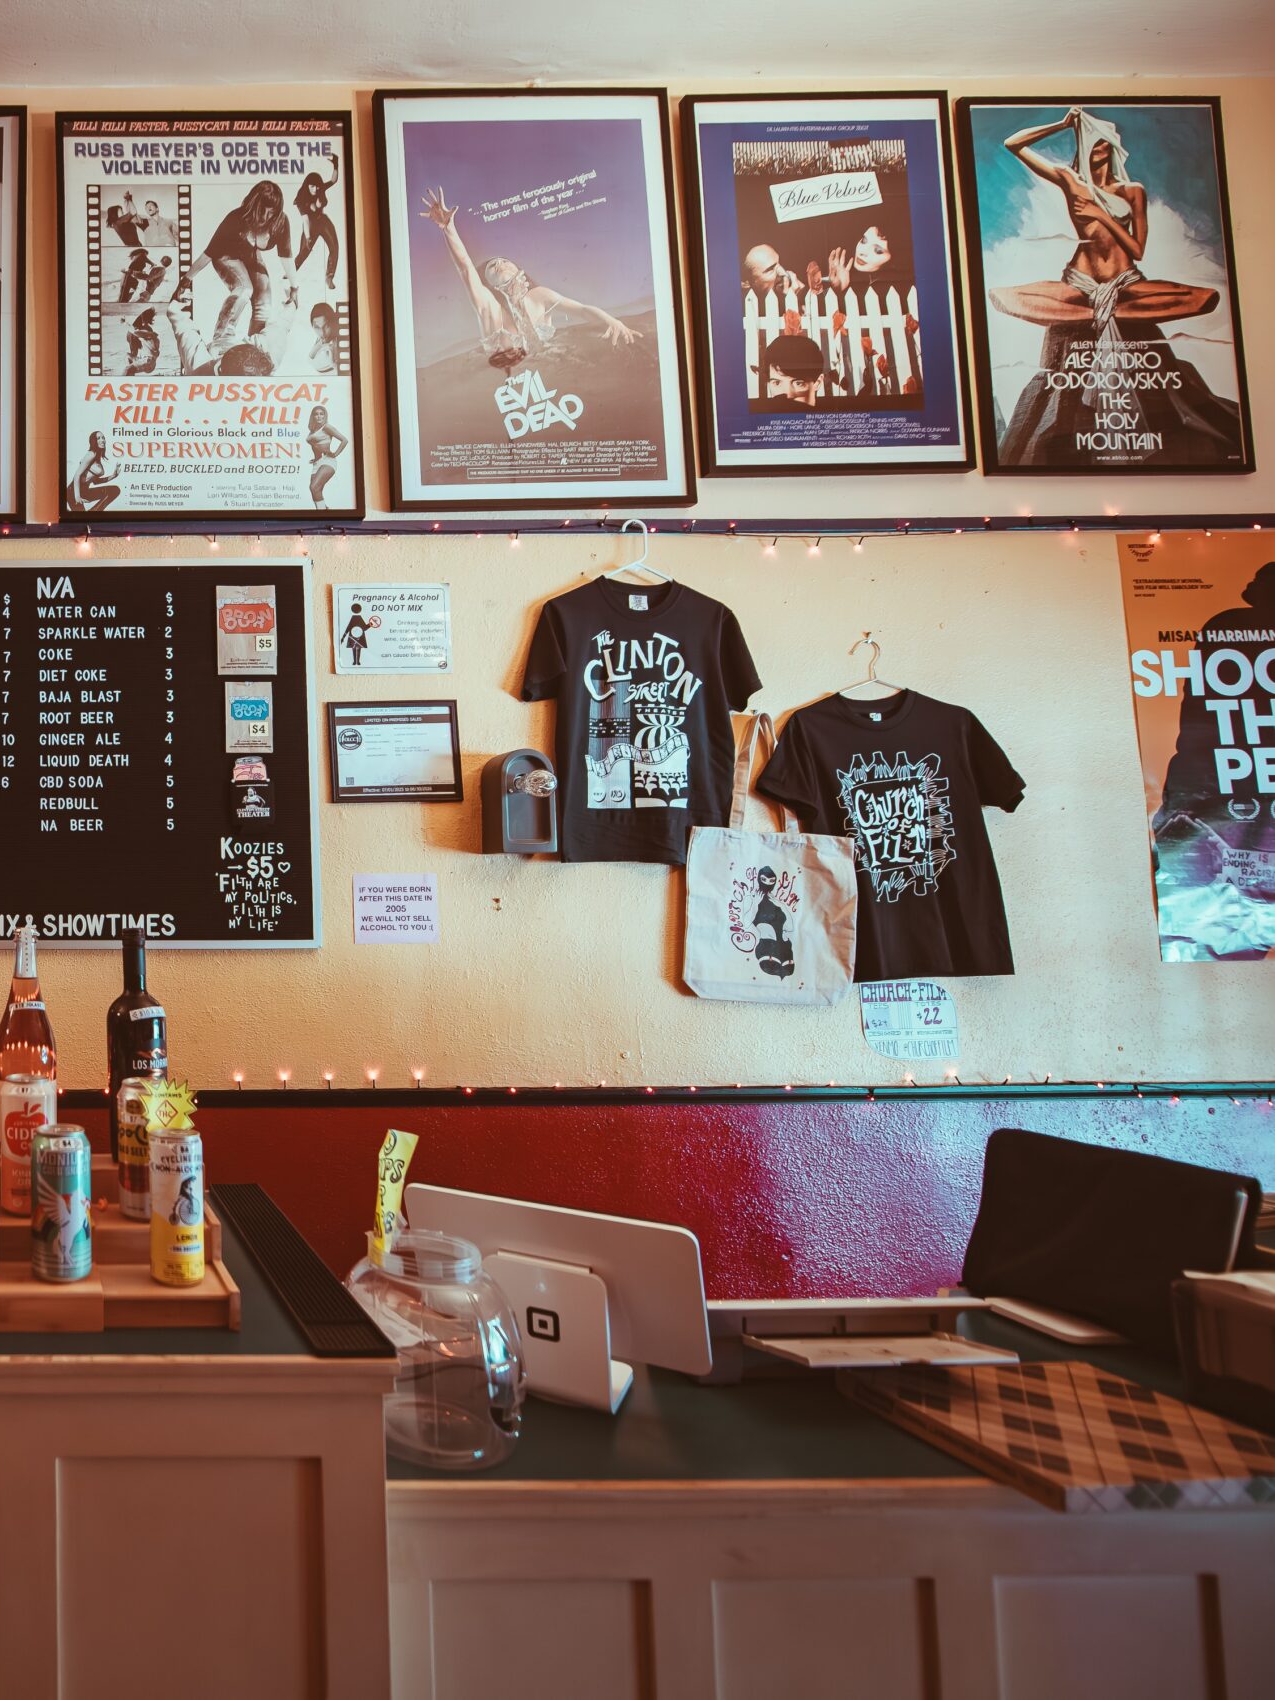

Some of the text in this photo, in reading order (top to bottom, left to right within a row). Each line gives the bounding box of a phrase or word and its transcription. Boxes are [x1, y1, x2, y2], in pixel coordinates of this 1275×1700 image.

[75, 143, 214, 157] RUSS MEYER'S
[102, 160, 304, 175] VIOLENCE IN WOMEN
[779, 180, 876, 209] Blue Velvet
[1065, 351, 1161, 369] ALEXANDRO
[1044, 372, 1182, 389] JODOROWSKY'S
[85, 383, 178, 402] FASTER
[494, 369, 557, 414] EVIL
[1099, 393, 1131, 409] THE
[114, 406, 301, 424] KILL! KILL!
[504, 394, 583, 439] DEAD
[1095, 412, 1139, 429] HOLY
[113, 427, 246, 437] Filmed Glorious Black
[1077, 432, 1162, 449] MOUNTAIN
[112, 442, 300, 458] SUPERWOMEN!
[37, 576, 74, 600] N/A
[353, 594, 397, 602] Pregnancy
[37, 606, 115, 618] WATER CAN
[39, 627, 144, 639] SPARKLE WATER
[1159, 631, 1202, 642] MISAN
[259, 639, 271, 649] $5
[39, 649, 72, 660] COKE
[40, 669, 106, 681] DIET COKE
[584, 632, 702, 705] CLINTON
[40, 690, 121, 703] BAJA BLAST
[624, 681, 670, 703] STREET
[40, 712, 113, 724] ROOT BEER
[637, 708, 685, 716] THEATER
[253, 725, 265, 734] $4
[39, 733, 120, 747] GINGER ALE
[40, 754, 128, 767] LIQUID DEATH
[40, 776, 103, 788] CBD SODA
[40, 798, 98, 809] REDBULL
[221, 837, 283, 861] KOOZIES
[247, 856, 275, 880] $5
[861, 983, 947, 1003] CHURCH FILM
[133, 1060, 147, 1069] LOS
